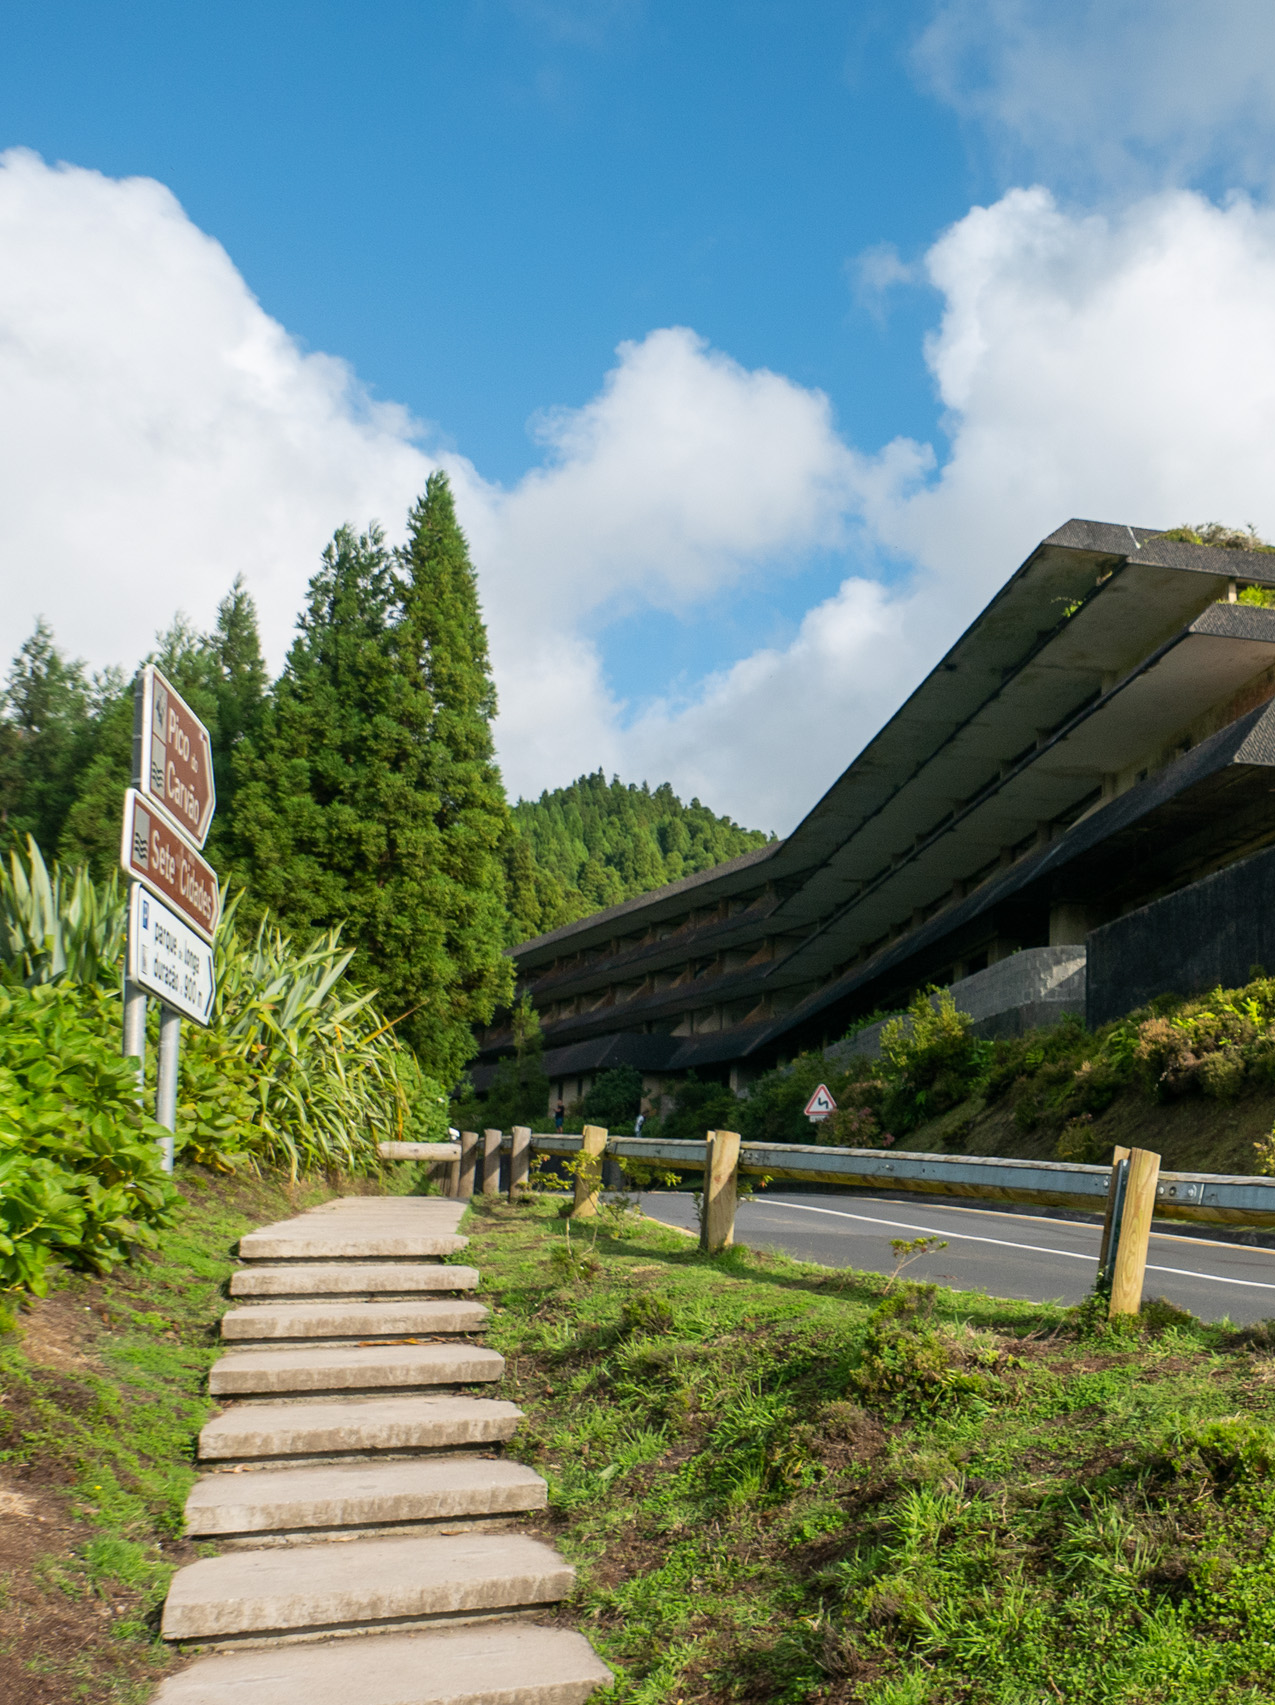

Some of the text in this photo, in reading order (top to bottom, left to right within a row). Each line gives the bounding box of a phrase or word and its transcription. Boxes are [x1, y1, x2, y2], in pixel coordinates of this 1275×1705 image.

[168, 708, 190, 762] Pico
[167, 760, 200, 825] Carvão
[151, 829, 212, 920] Sete Cidades
